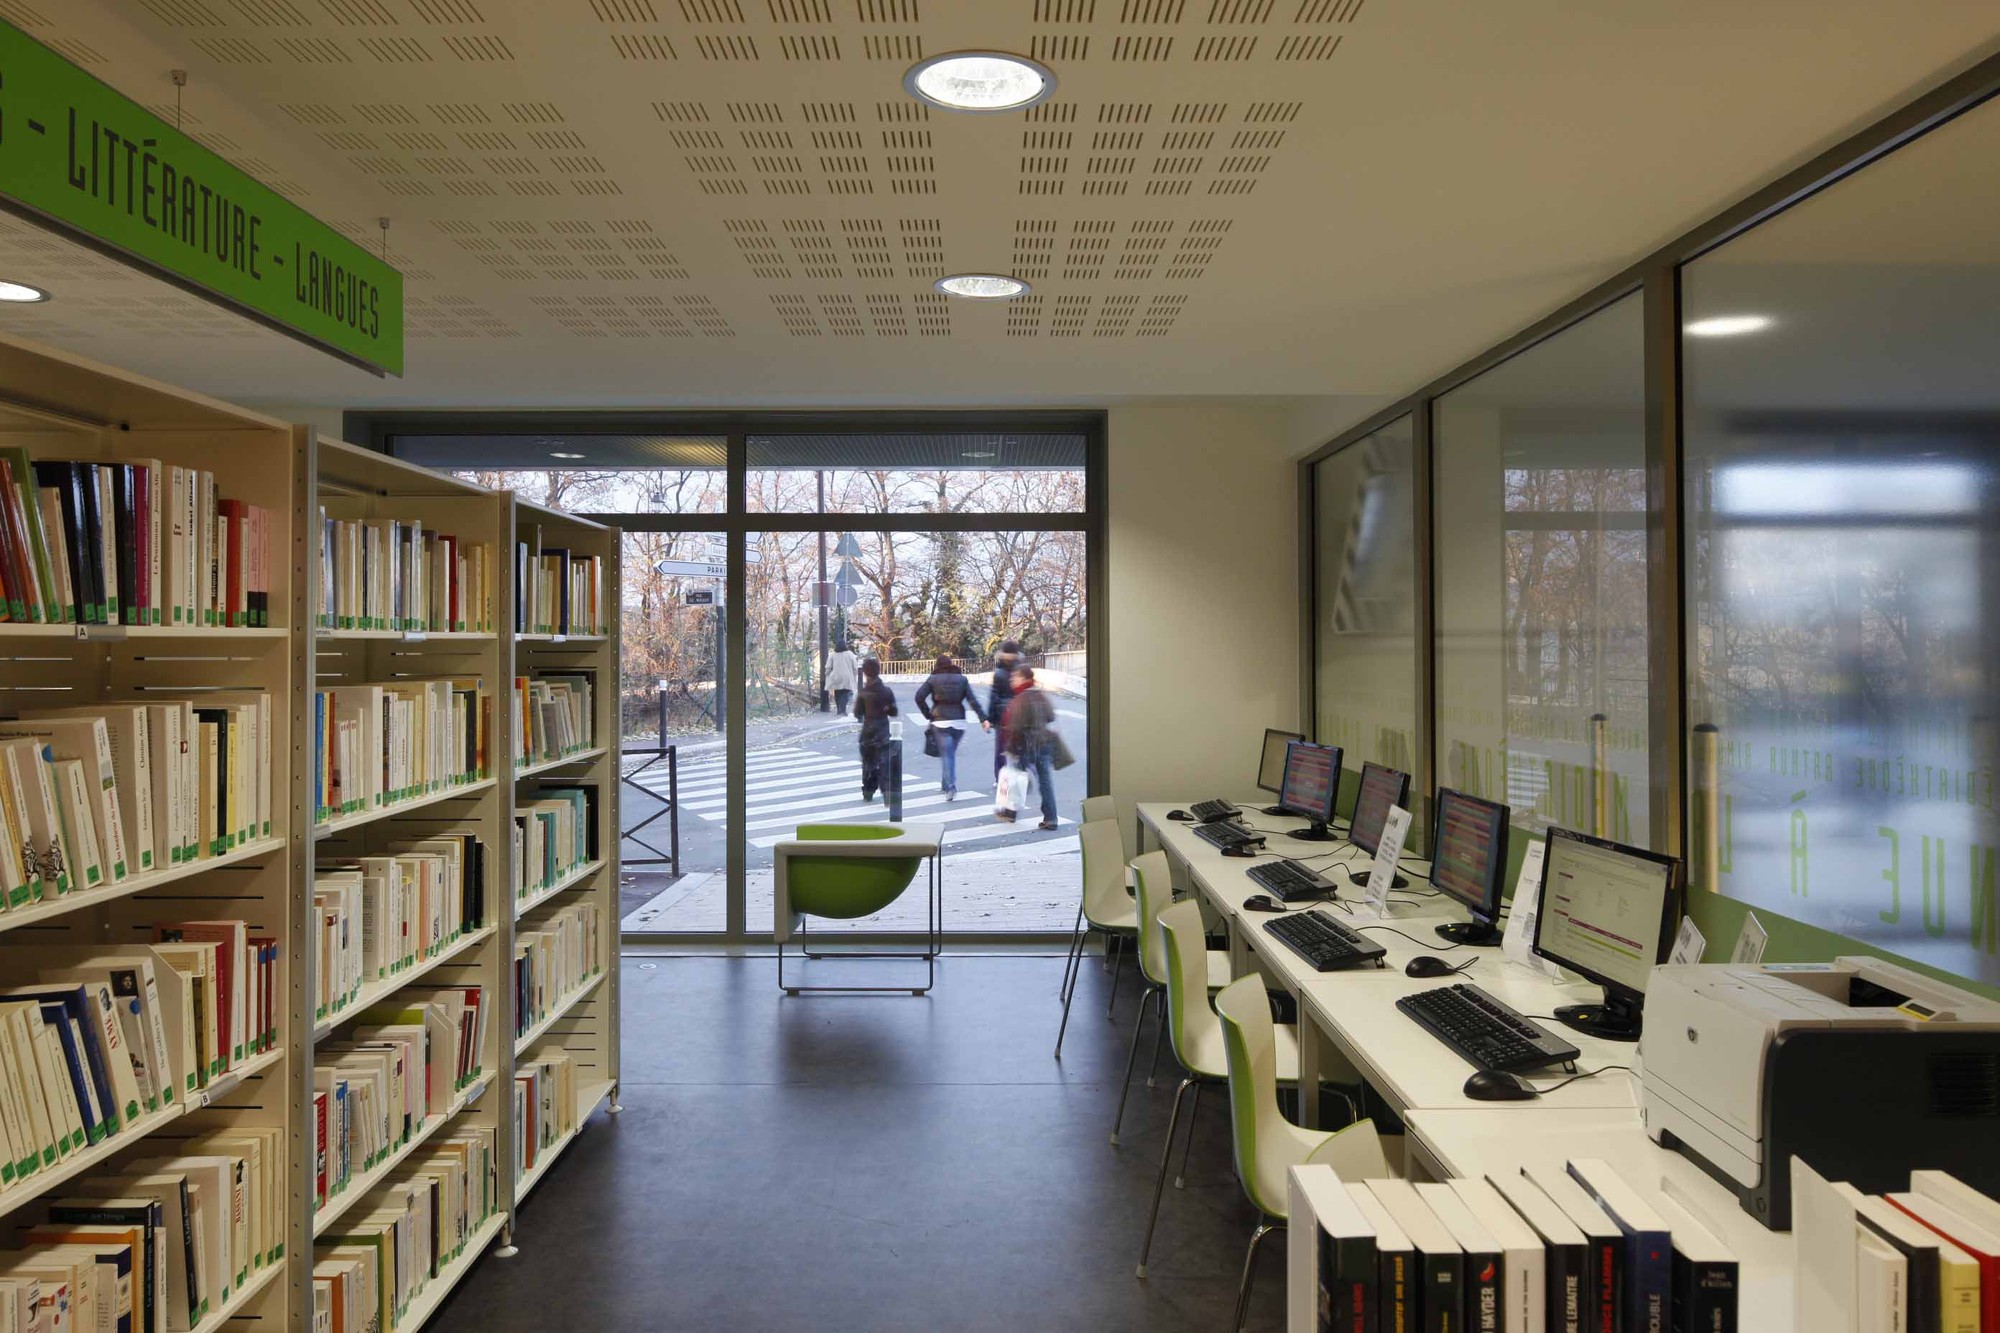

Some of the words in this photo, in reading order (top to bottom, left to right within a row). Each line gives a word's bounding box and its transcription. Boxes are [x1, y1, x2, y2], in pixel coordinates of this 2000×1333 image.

[68, 106, 262, 281] LITTÉRATURE
[296, 241, 379, 340] LANGUES
[80, 627, 87, 638] A
[202, 1095, 208, 1103] B
[1480, 1286, 1496, 1330] HAYDER
[1565, 1274, 1579, 1320] LEMAITRE
[1648, 1292, 1661, 1333] ROUBLE
[1602, 1303, 1613, 1333] OUCE
